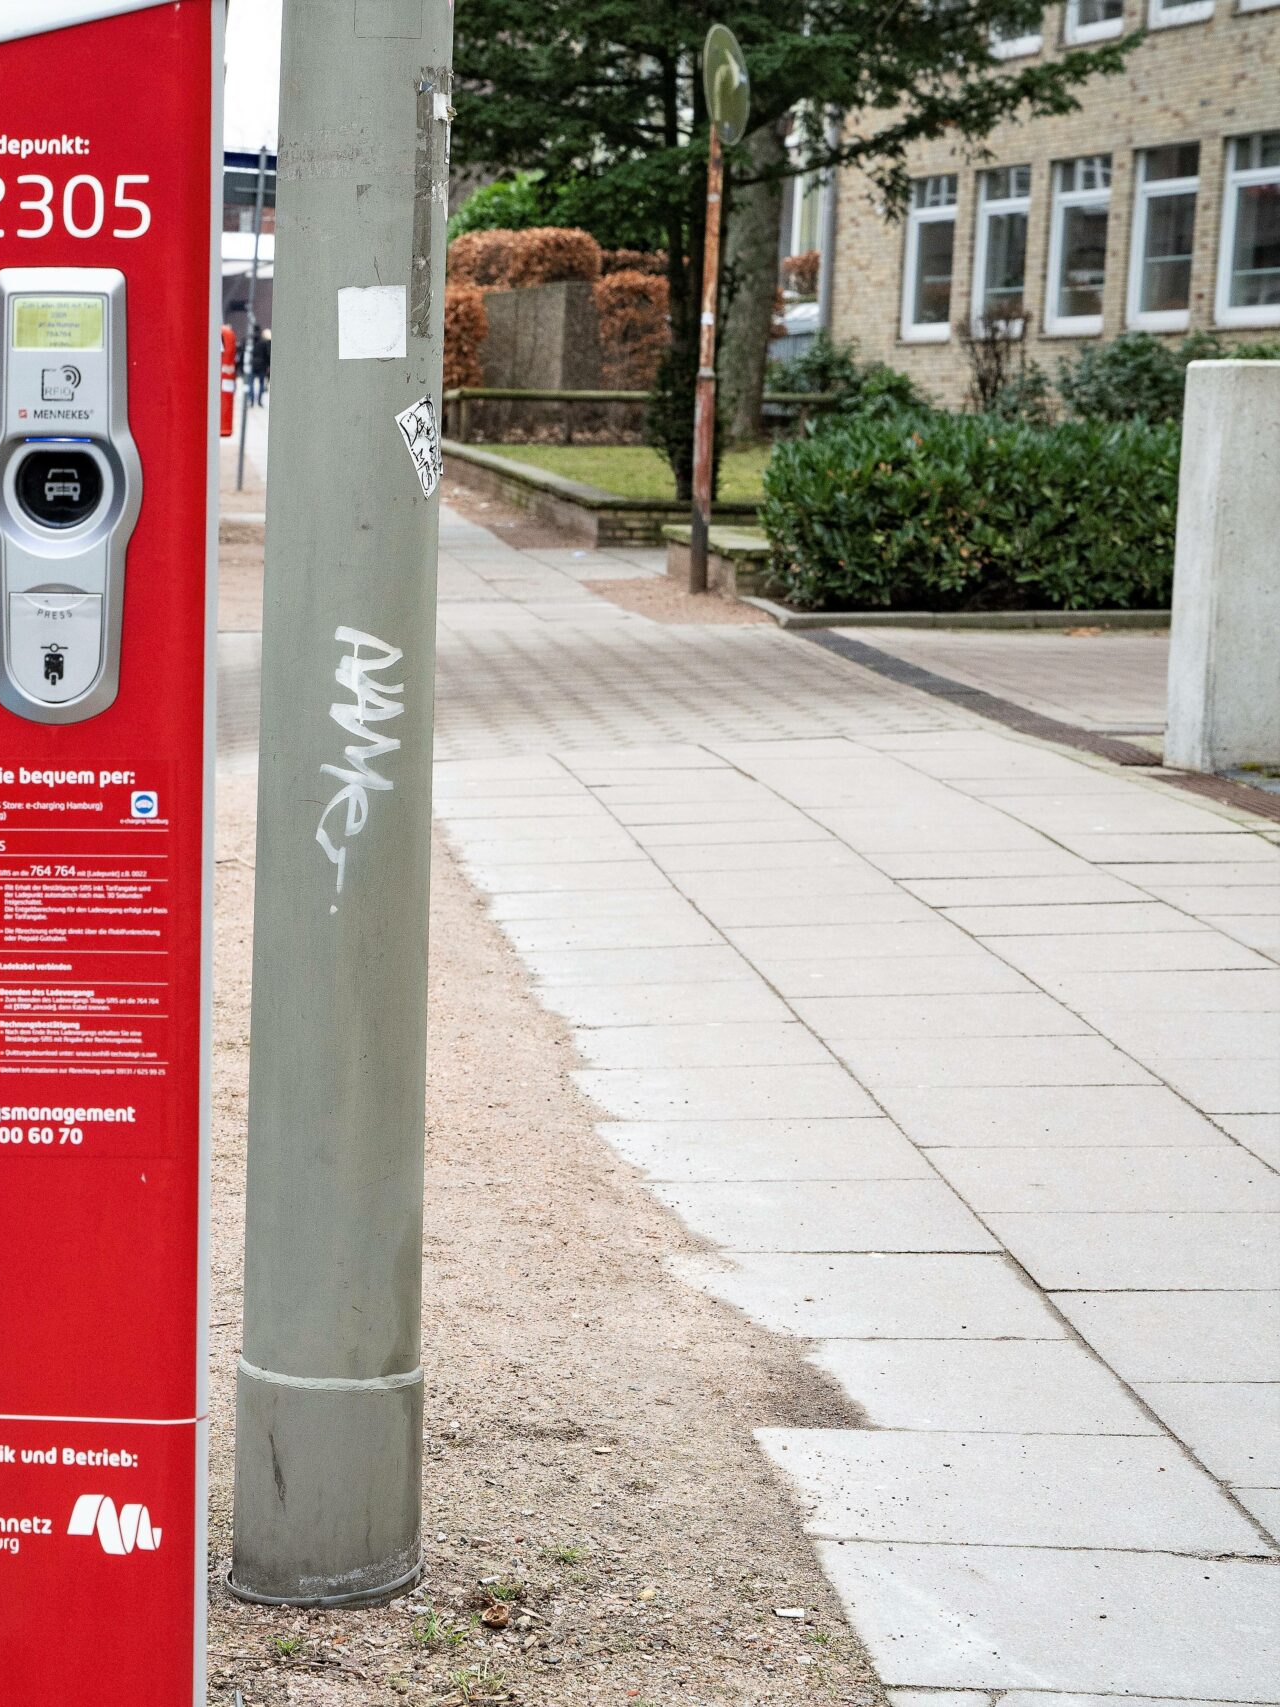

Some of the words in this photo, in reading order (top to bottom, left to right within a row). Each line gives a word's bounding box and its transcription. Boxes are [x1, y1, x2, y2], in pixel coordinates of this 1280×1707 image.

[45, 386, 72, 396] RFID
[36, 608, 72, 620] PRESS
[19, 767, 94, 787] bequem
[100, 771, 135, 788] per:
[2, 802, 24, 810] Store:
[26, 802, 65, 811] e-charging
[66, 802, 103, 811] Hamburg)
[30, 865, 52, 876] 764
[54, 865, 76, 876] 764
[36, 962, 72, 971] verbinden
[28, 1127, 53, 1144] 60
[59, 1127, 83, 1144] 70
[21, 1447, 57, 1464] und
[62, 1448, 138, 1467] Betrieb:
